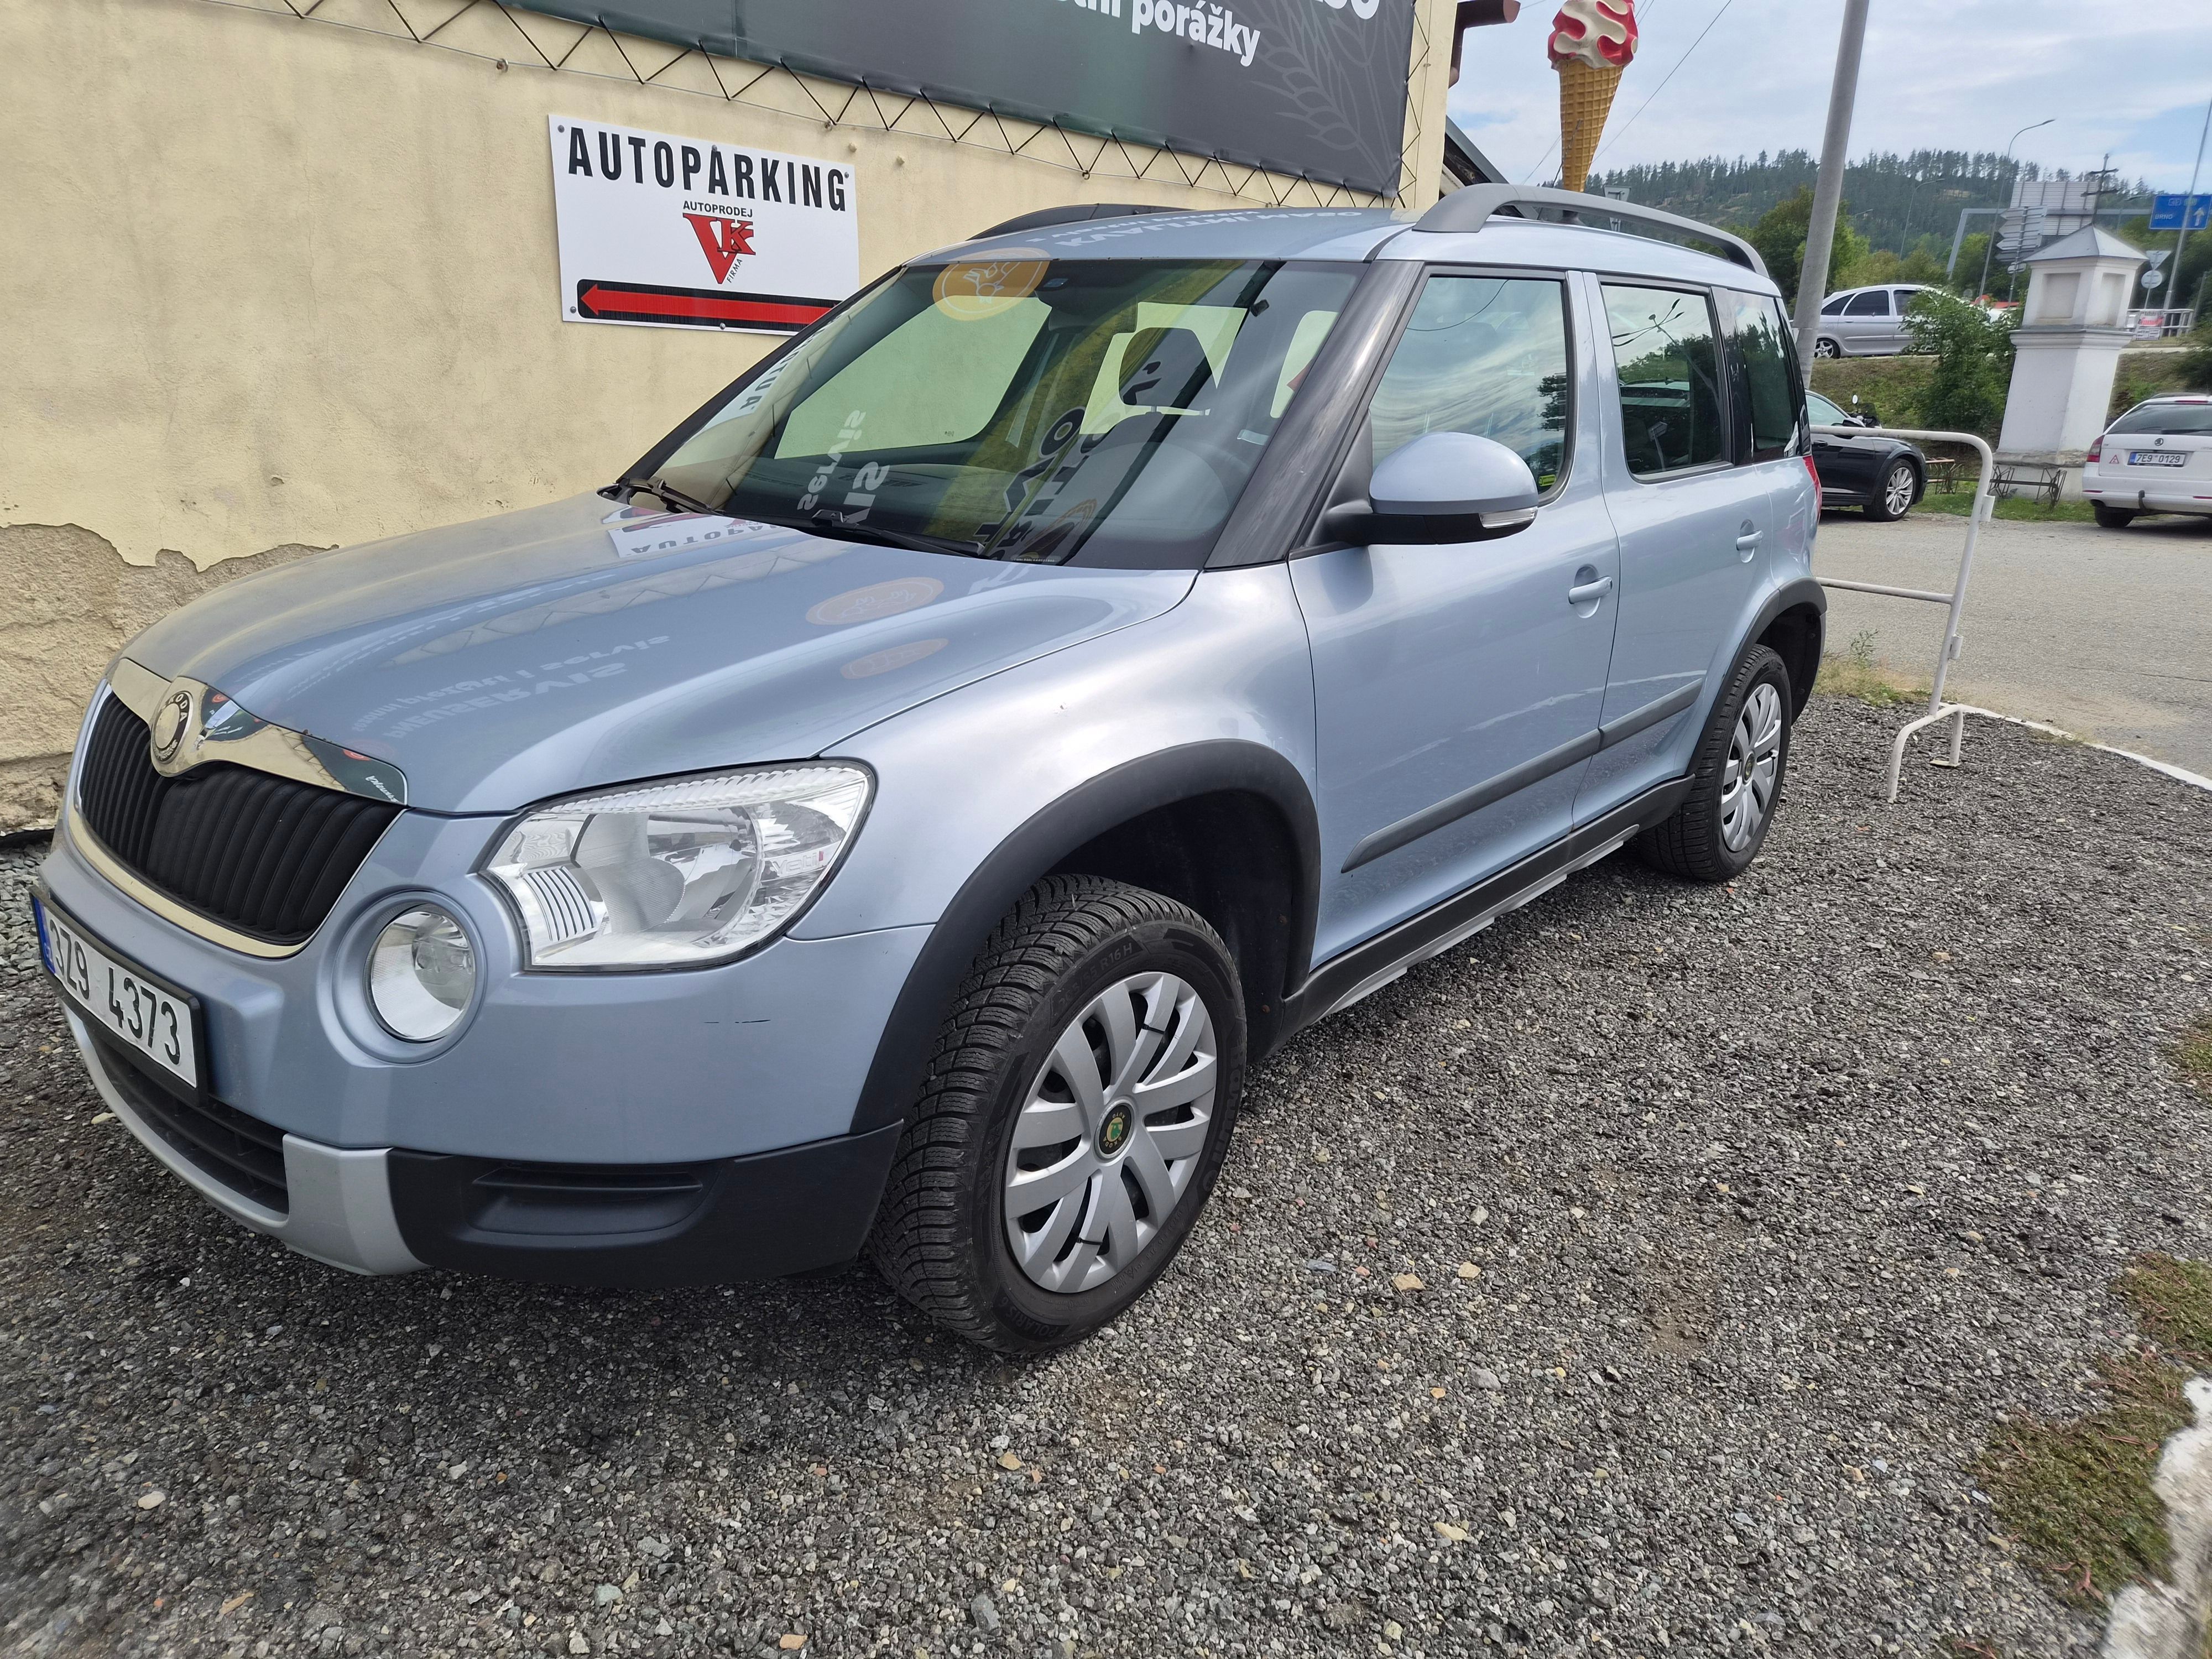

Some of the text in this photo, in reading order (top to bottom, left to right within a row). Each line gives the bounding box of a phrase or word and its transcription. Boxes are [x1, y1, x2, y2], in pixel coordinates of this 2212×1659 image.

[1131, 0, 1261, 67] porážky
[568, 127, 846, 211] AUTOPARKING
[682, 200, 753, 218] AUTOPRODEJ
[727, 258, 743, 284] FIRMA
[2136, 454, 2180, 463] 7E9 0129
[50, 918, 181, 1066] 3Z9 4373
